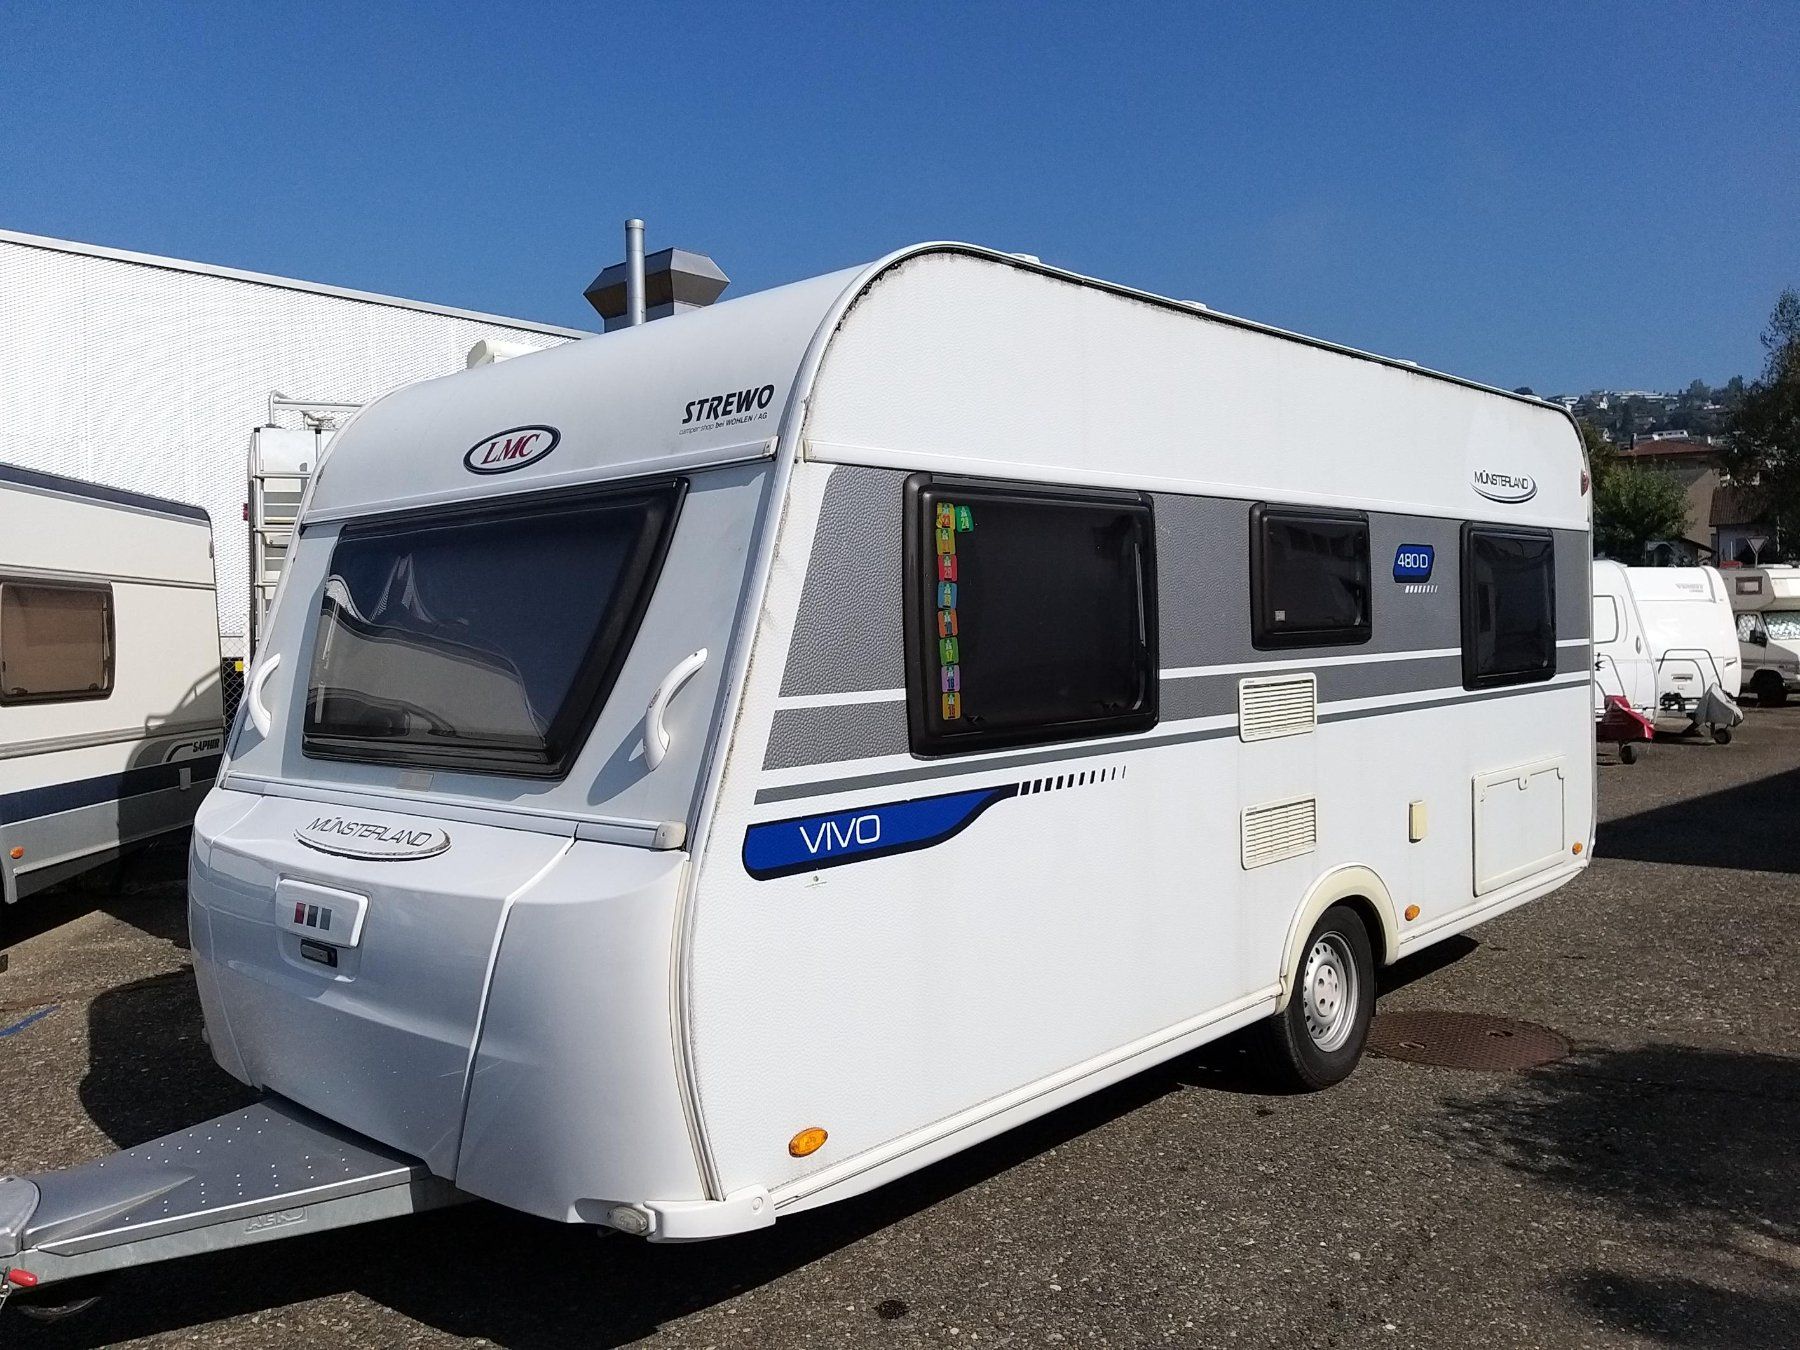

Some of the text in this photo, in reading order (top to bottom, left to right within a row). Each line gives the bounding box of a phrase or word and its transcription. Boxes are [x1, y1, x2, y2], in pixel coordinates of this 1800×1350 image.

[682, 384, 775, 425] STREWO
[481, 433, 541, 465] LMC
[1474, 469, 1529, 490] MÜNSTERLAND
[193, 738, 220, 752] SAPHIR
[306, 816, 433, 847] MÜNSTERLAND
[799, 814, 881, 854] VIVO
